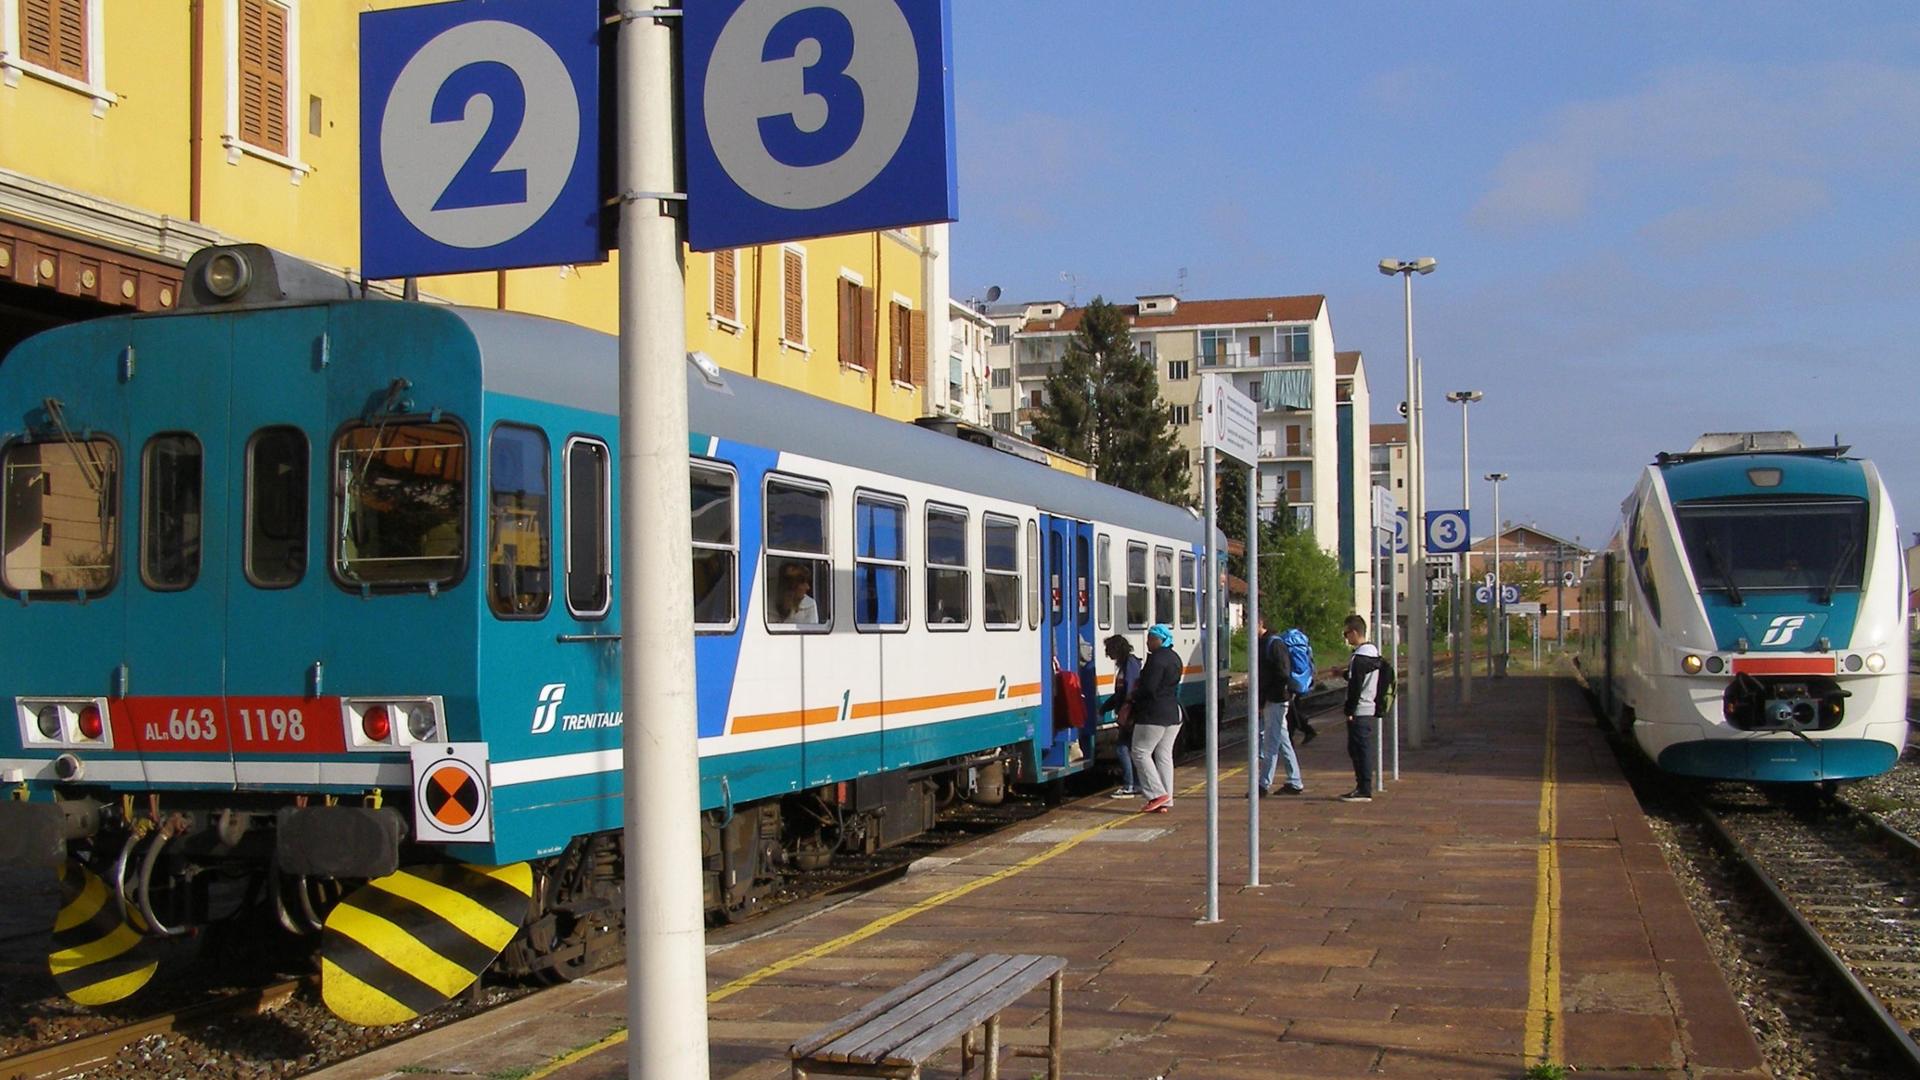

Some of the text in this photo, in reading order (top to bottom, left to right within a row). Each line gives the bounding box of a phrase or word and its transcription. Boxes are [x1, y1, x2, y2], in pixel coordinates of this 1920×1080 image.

[757, 6, 866, 168] 3
[429, 60, 528, 212] 2
[1440, 519, 1458, 544] 3
[1505, 589, 1514, 600] 3
[998, 674, 1007, 700] 2
[841, 688, 850, 721] 1
[239, 708, 306, 742] 1198
